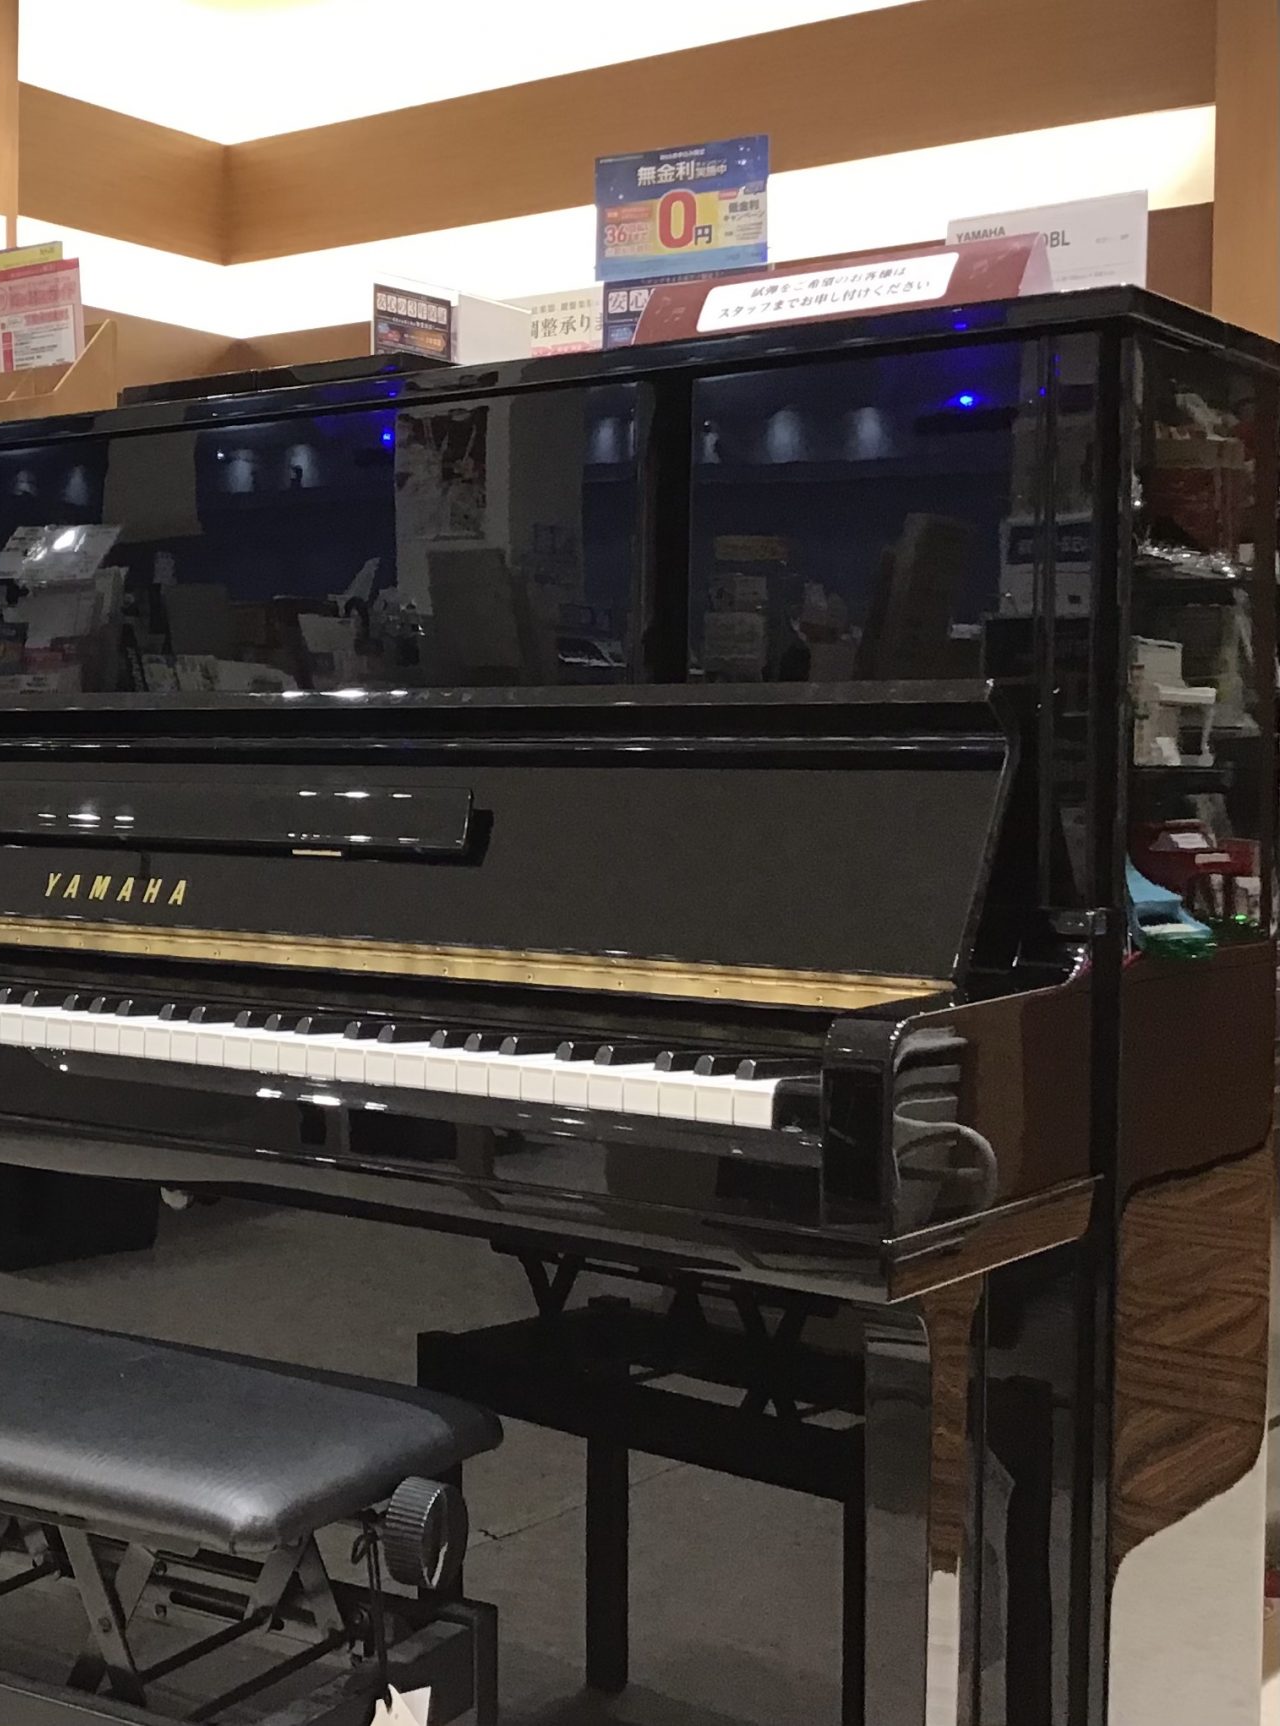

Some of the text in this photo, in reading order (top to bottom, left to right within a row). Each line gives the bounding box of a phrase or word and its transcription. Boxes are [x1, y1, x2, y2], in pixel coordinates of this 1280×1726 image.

[637, 160, 695, 187] 無金利
[956, 226, 1006, 243] YAMAHA
[718, 280, 931, 319] スタッフまでお申し付けください
[44, 872, 188, 906] YAMAHA
